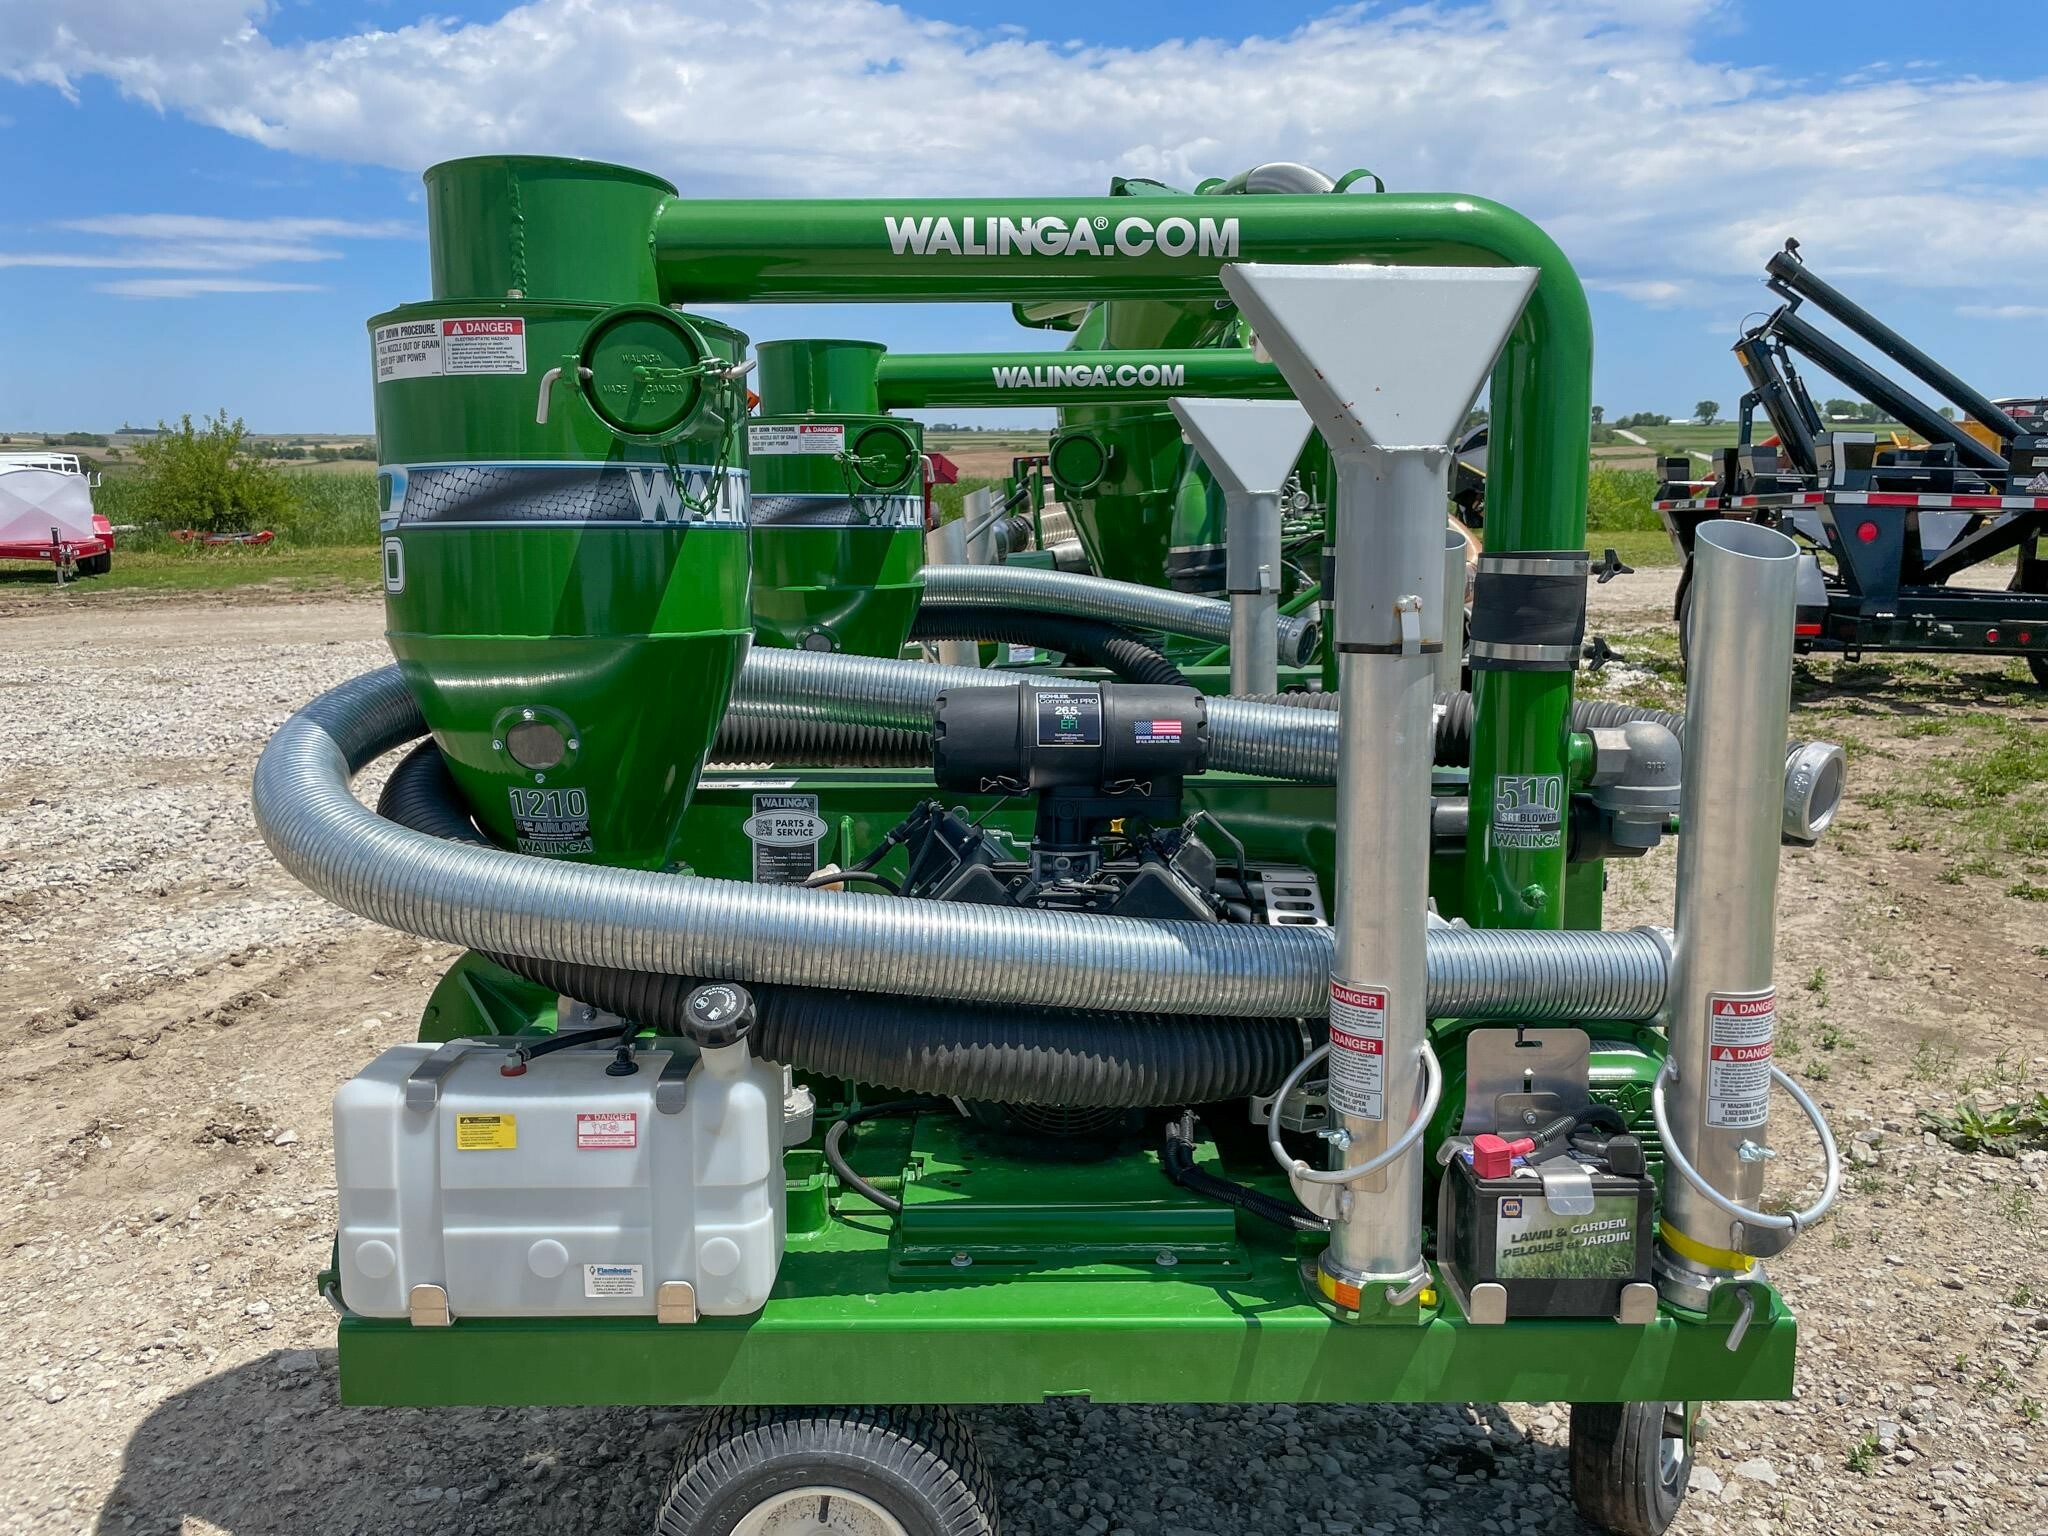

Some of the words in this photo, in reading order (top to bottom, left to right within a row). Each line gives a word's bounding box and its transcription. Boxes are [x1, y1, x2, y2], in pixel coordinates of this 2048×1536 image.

[400, 323, 436, 337] PROCEDURE
[466, 322, 513, 333] DANGER
[403, 341, 412, 351] OUT
[413, 340, 421, 350] OF
[421, 339, 440, 349] GRAIN
[407, 352, 427, 362] POWER
[622, 354, 662, 363] WALINGA
[602, 384, 629, 394] MADE
[646, 384, 684, 394] CANADA
[1061, 720, 1078, 729] EFI
[1497, 776, 1561, 812] 510
[510, 788, 587, 819] 1210
[760, 798, 810, 808] WALINGA
[534, 820, 589, 833] AIRLOCK
[775, 819, 803, 828] PARTS
[807, 819, 815, 828] &
[776, 828, 814, 837] SERVICE
[1335, 989, 1377, 1007] DANGER
[1334, 1032, 1376, 1052] DANGER
[1343, 1102, 1357, 1111] MORE
[594, 1113, 632, 1121] DANGER
[1511, 1229, 1552, 1243] LAWN
[1556, 1228, 1567, 1237] &
[1570, 1218, 1627, 1235] GARDEN
[1502, 1242, 1564, 1258] PELOUSE
[1566, 1240, 1579, 1249] et
[1581, 1231, 1632, 1247] JARDIN
